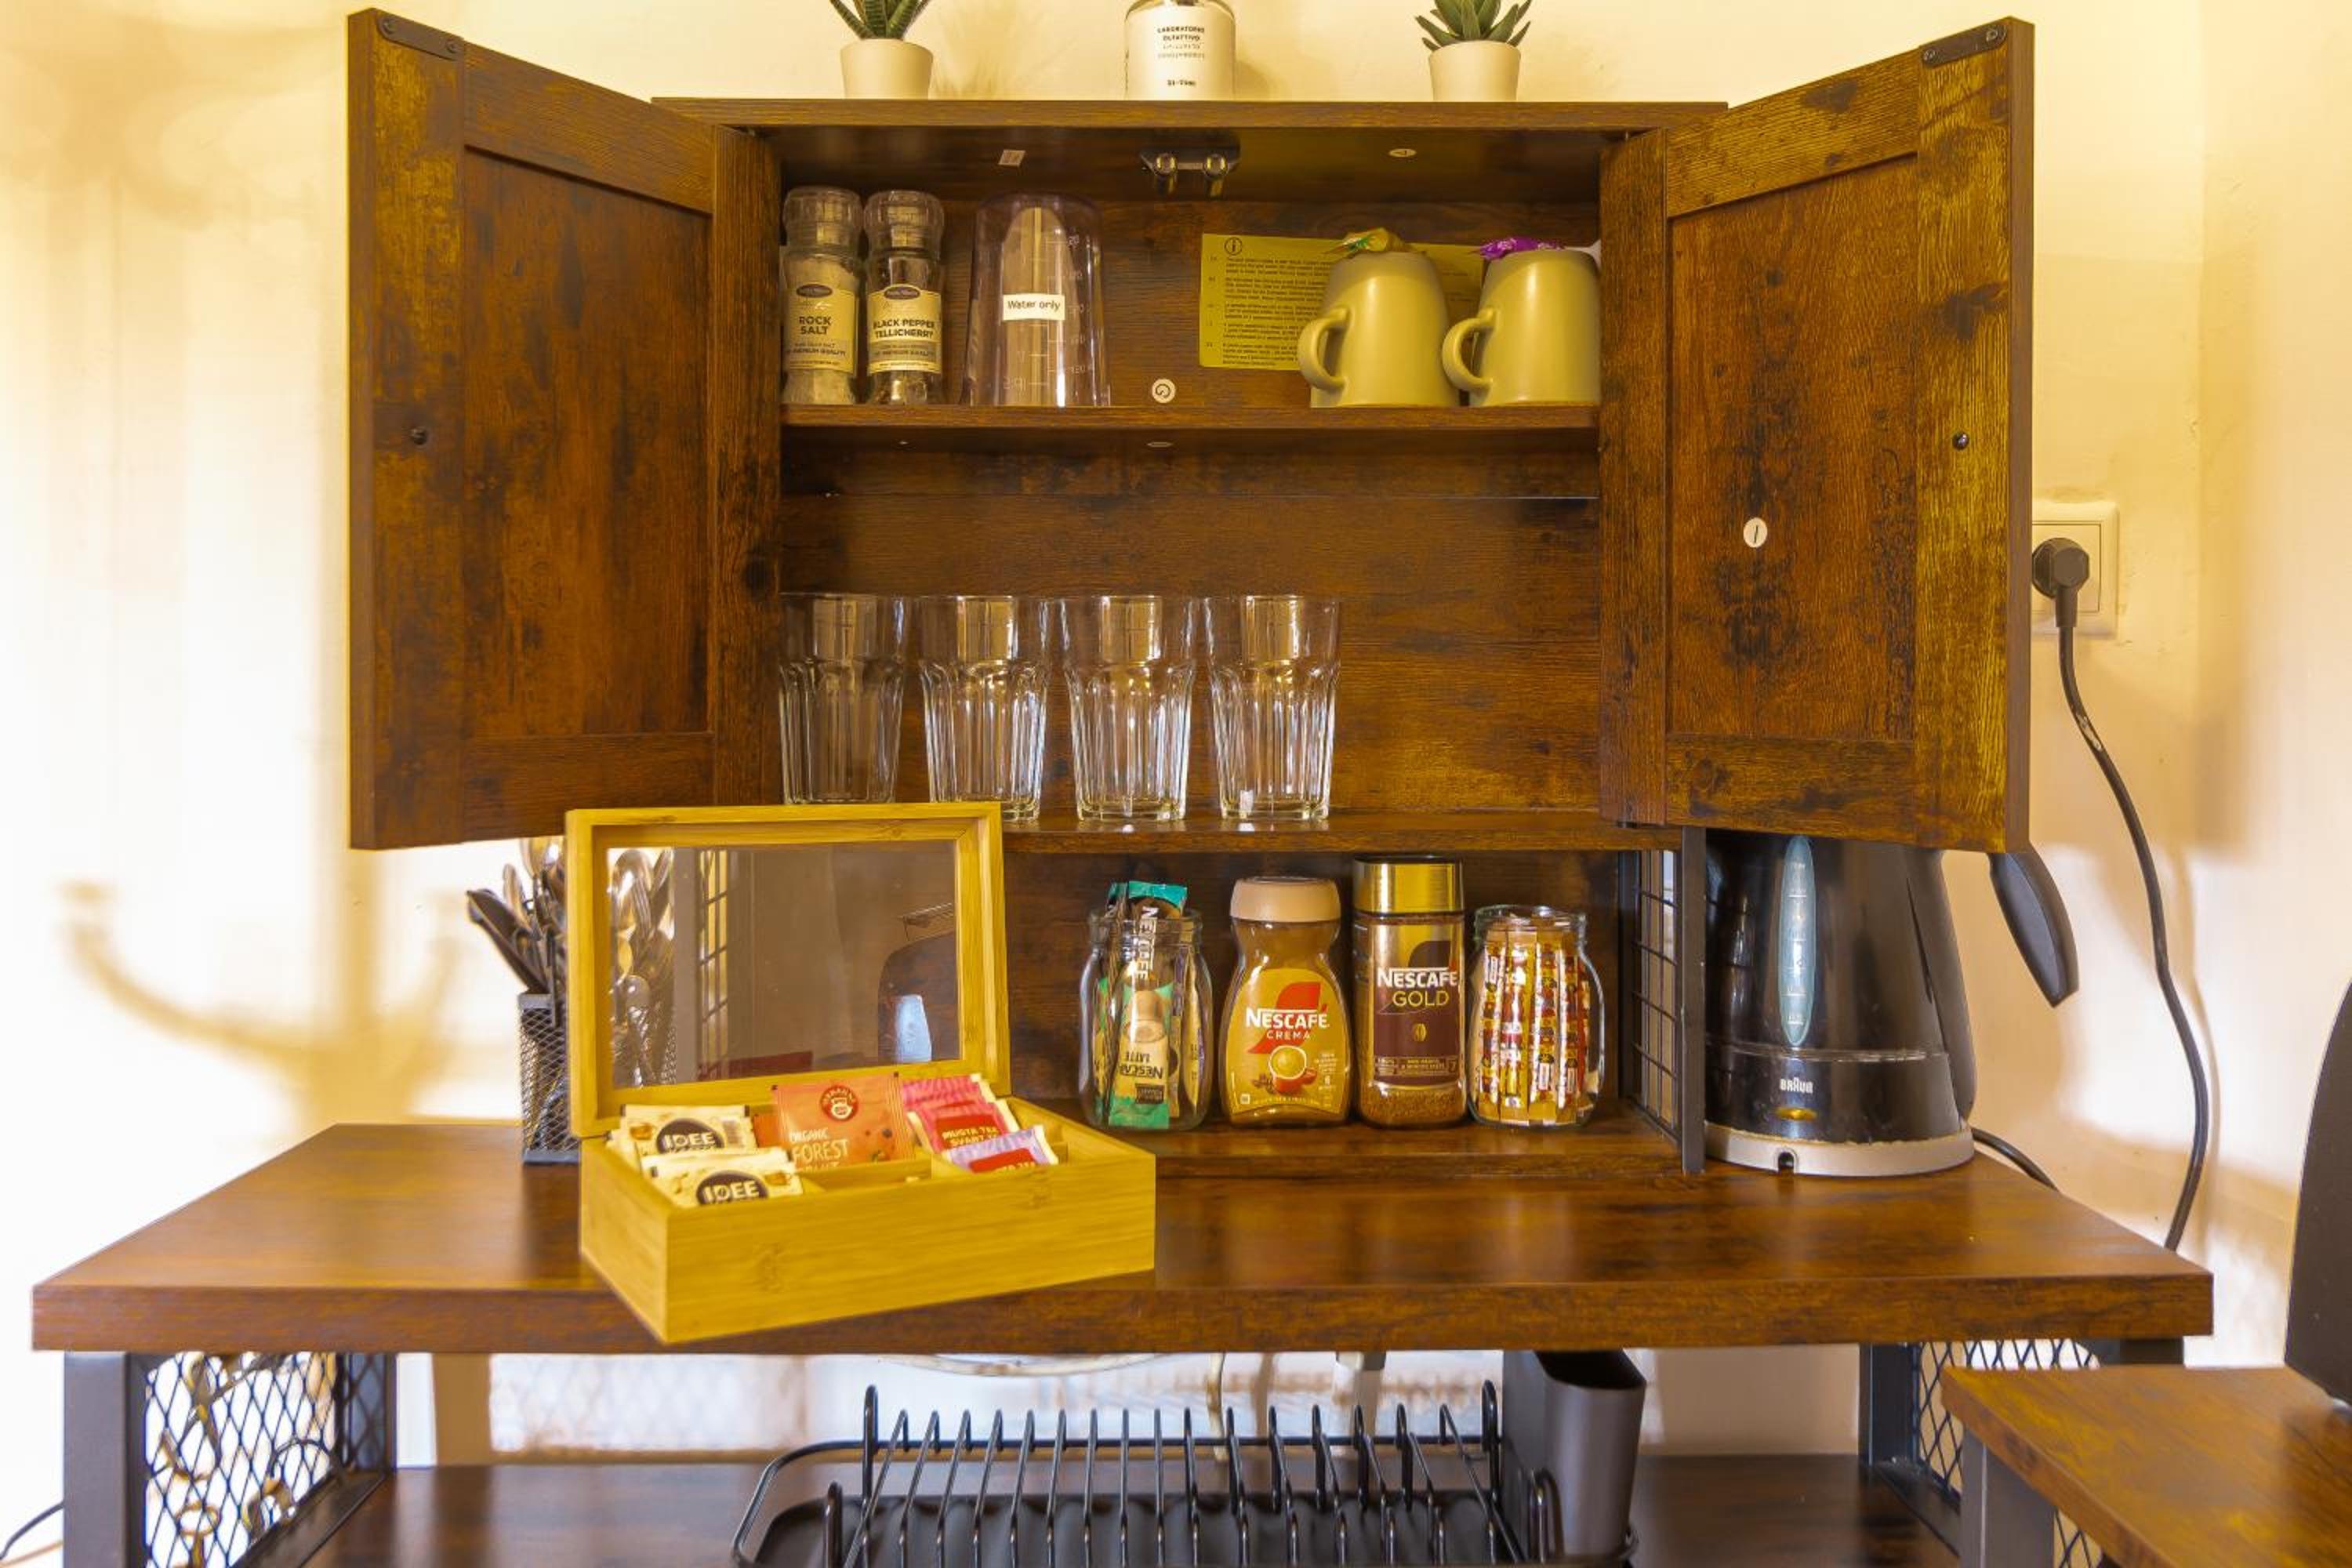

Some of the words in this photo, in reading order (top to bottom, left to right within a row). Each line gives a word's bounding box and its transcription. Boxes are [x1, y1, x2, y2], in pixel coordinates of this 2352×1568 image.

[1007, 300, 1036, 310] Water
[1039, 300, 1061, 310] only
[799, 316, 832, 325] ROCK
[873, 318, 899, 328] BLACK
[902, 318, 935, 328] PEPPER
[800, 325, 828, 335] SALT
[875, 328, 935, 339] TELLICHERRY
[1392, 990, 1450, 1007] GOLD
[1266, 1031, 1311, 1040] CREMA
[1780, 1077, 1813, 1094] BRAUN
[663, 1132, 716, 1148] IDEE
[792, 1138, 849, 1165] FOREST
[702, 1180, 759, 1204] IDEE
